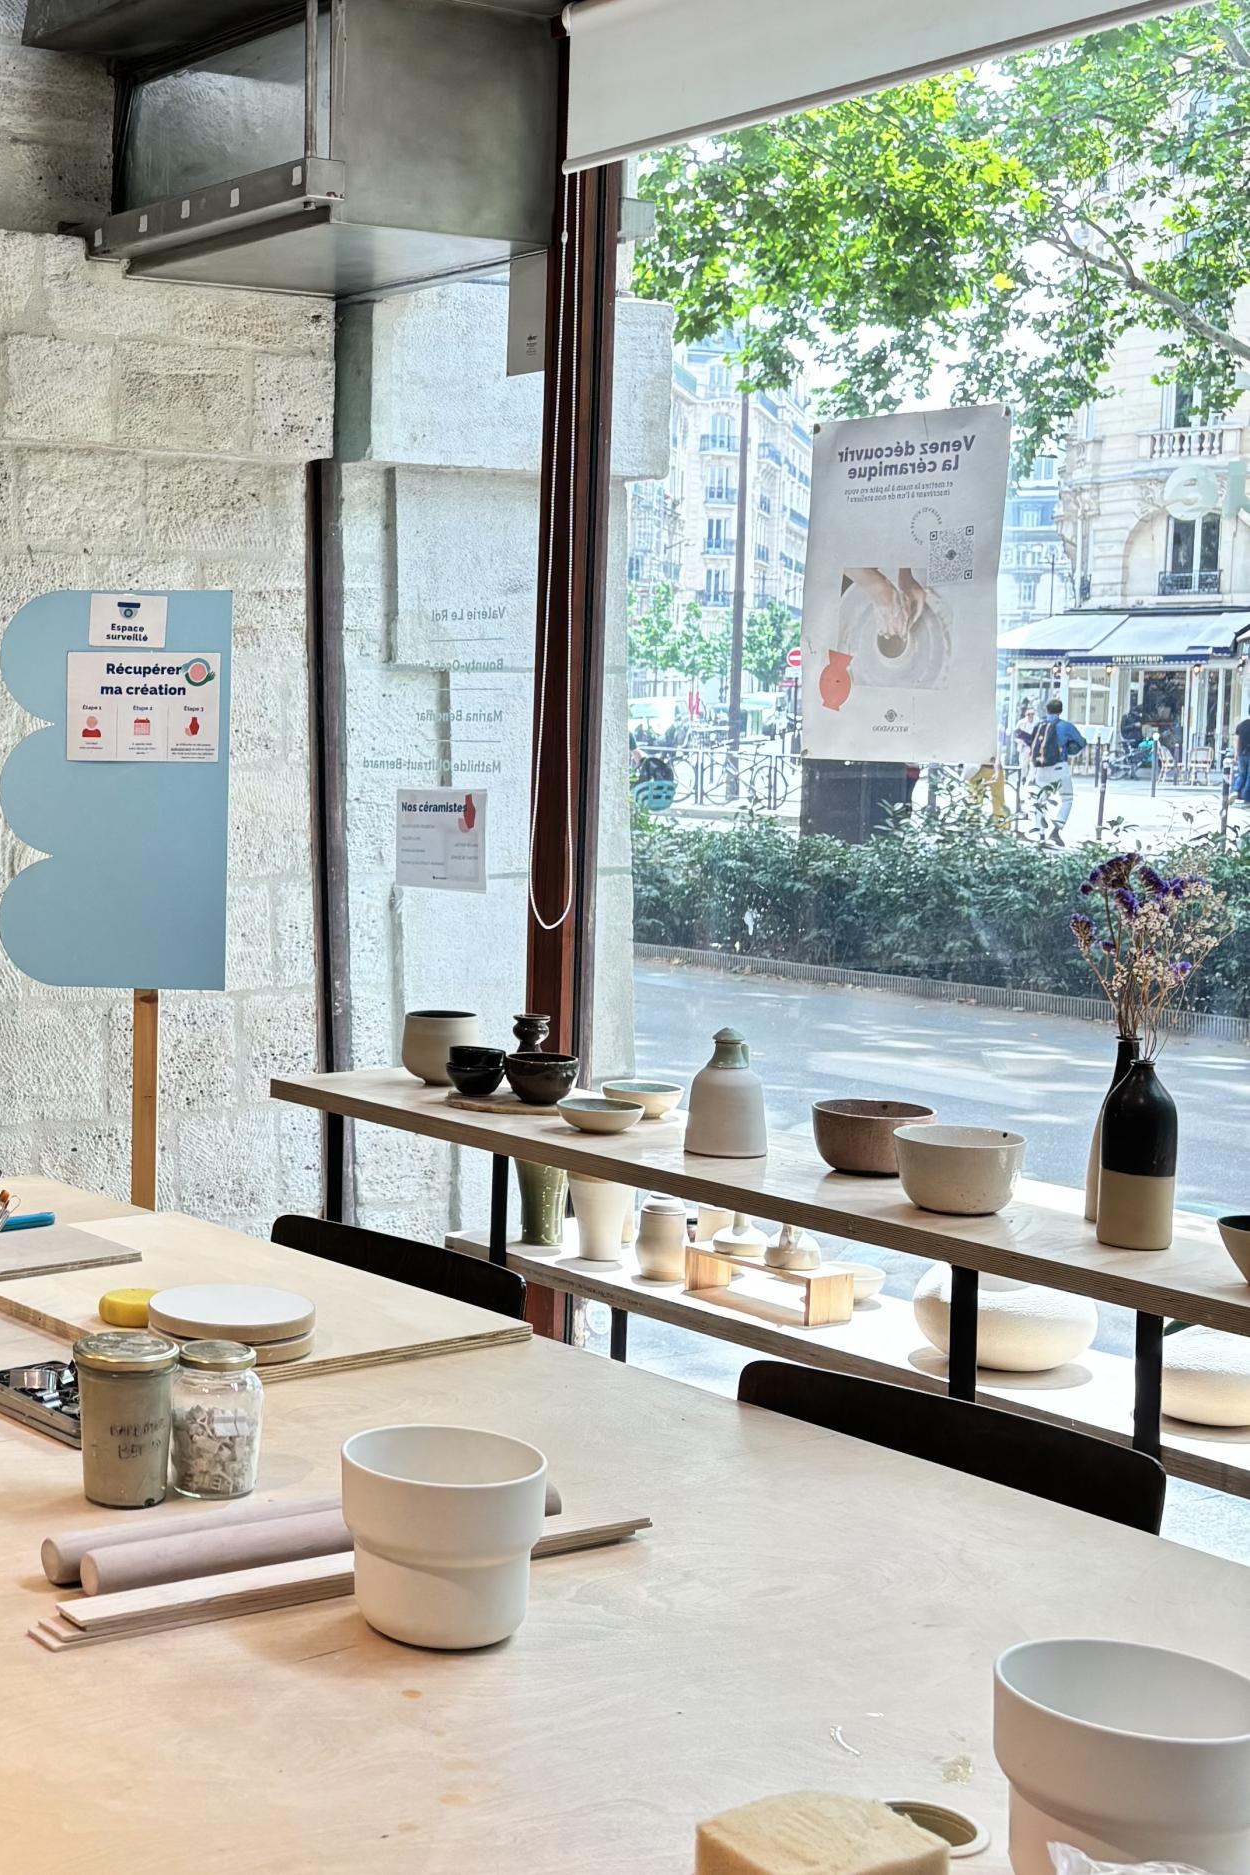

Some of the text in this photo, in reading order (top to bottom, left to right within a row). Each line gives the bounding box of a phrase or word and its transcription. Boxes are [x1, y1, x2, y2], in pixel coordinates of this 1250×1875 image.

[111, 624, 144, 632] Espace
[106, 633, 148, 642] surveillé
[106, 663, 182, 677] Récupérer
[100, 684, 186, 696] ma création
[402, 802, 468, 812] Nos céramistes
